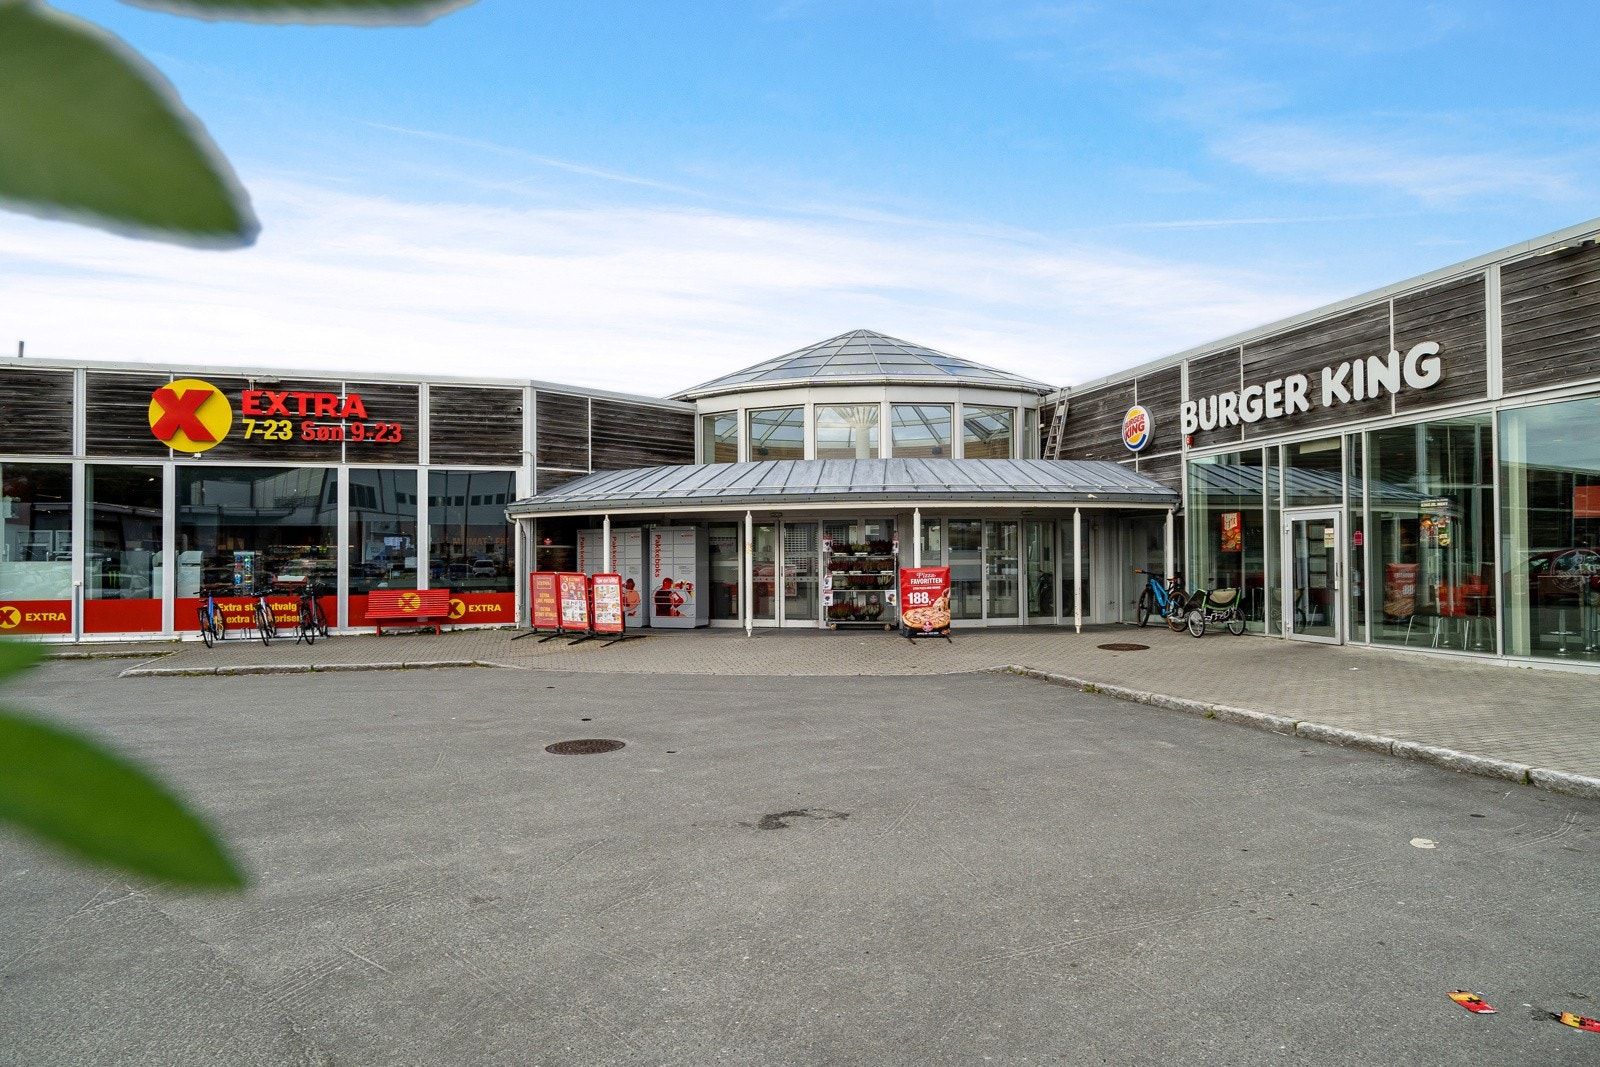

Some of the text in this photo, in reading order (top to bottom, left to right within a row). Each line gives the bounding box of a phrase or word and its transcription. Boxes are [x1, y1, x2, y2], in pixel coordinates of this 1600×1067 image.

[1180, 341, 1442, 435] BURGER KING
[241, 390, 368, 419] EXTRA
[242, 419, 402, 443] 7-23 Søn 9-23
[1125, 413, 1145, 430] BURGER
[1125, 421, 1145, 442] KING
[25, 613, 67, 621] EXTRA
[468, 604, 502, 612] EXTRA
